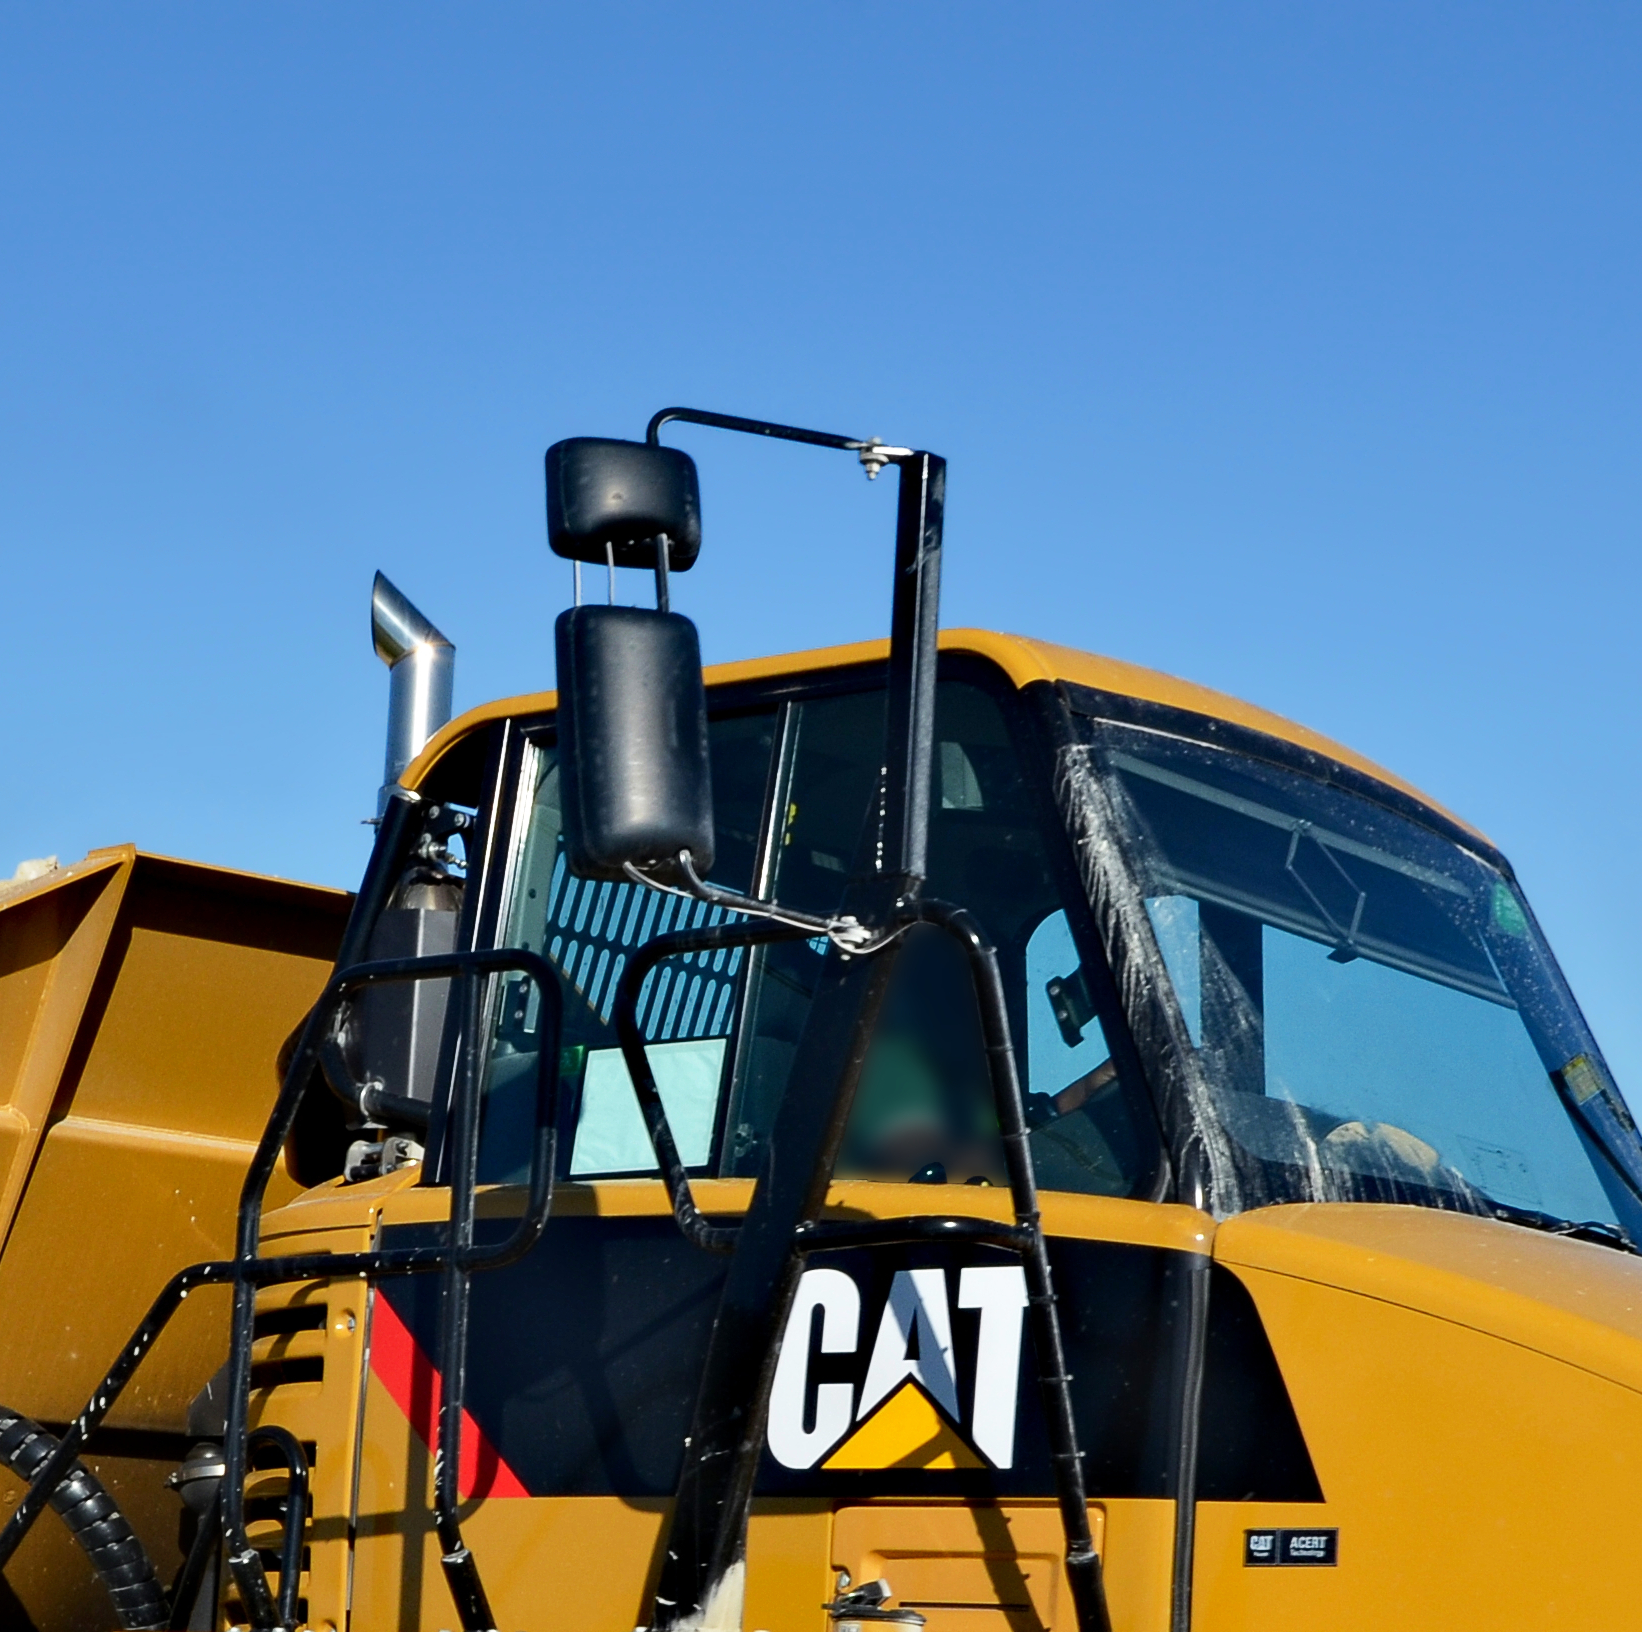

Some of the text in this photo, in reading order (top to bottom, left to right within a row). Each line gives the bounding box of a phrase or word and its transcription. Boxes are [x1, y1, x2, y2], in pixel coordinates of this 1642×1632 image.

[767, 1266, 1029, 1469] CAT
[1250, 1535, 1274, 1550] CAT
[1289, 1536, 1328, 1549] ACERT
